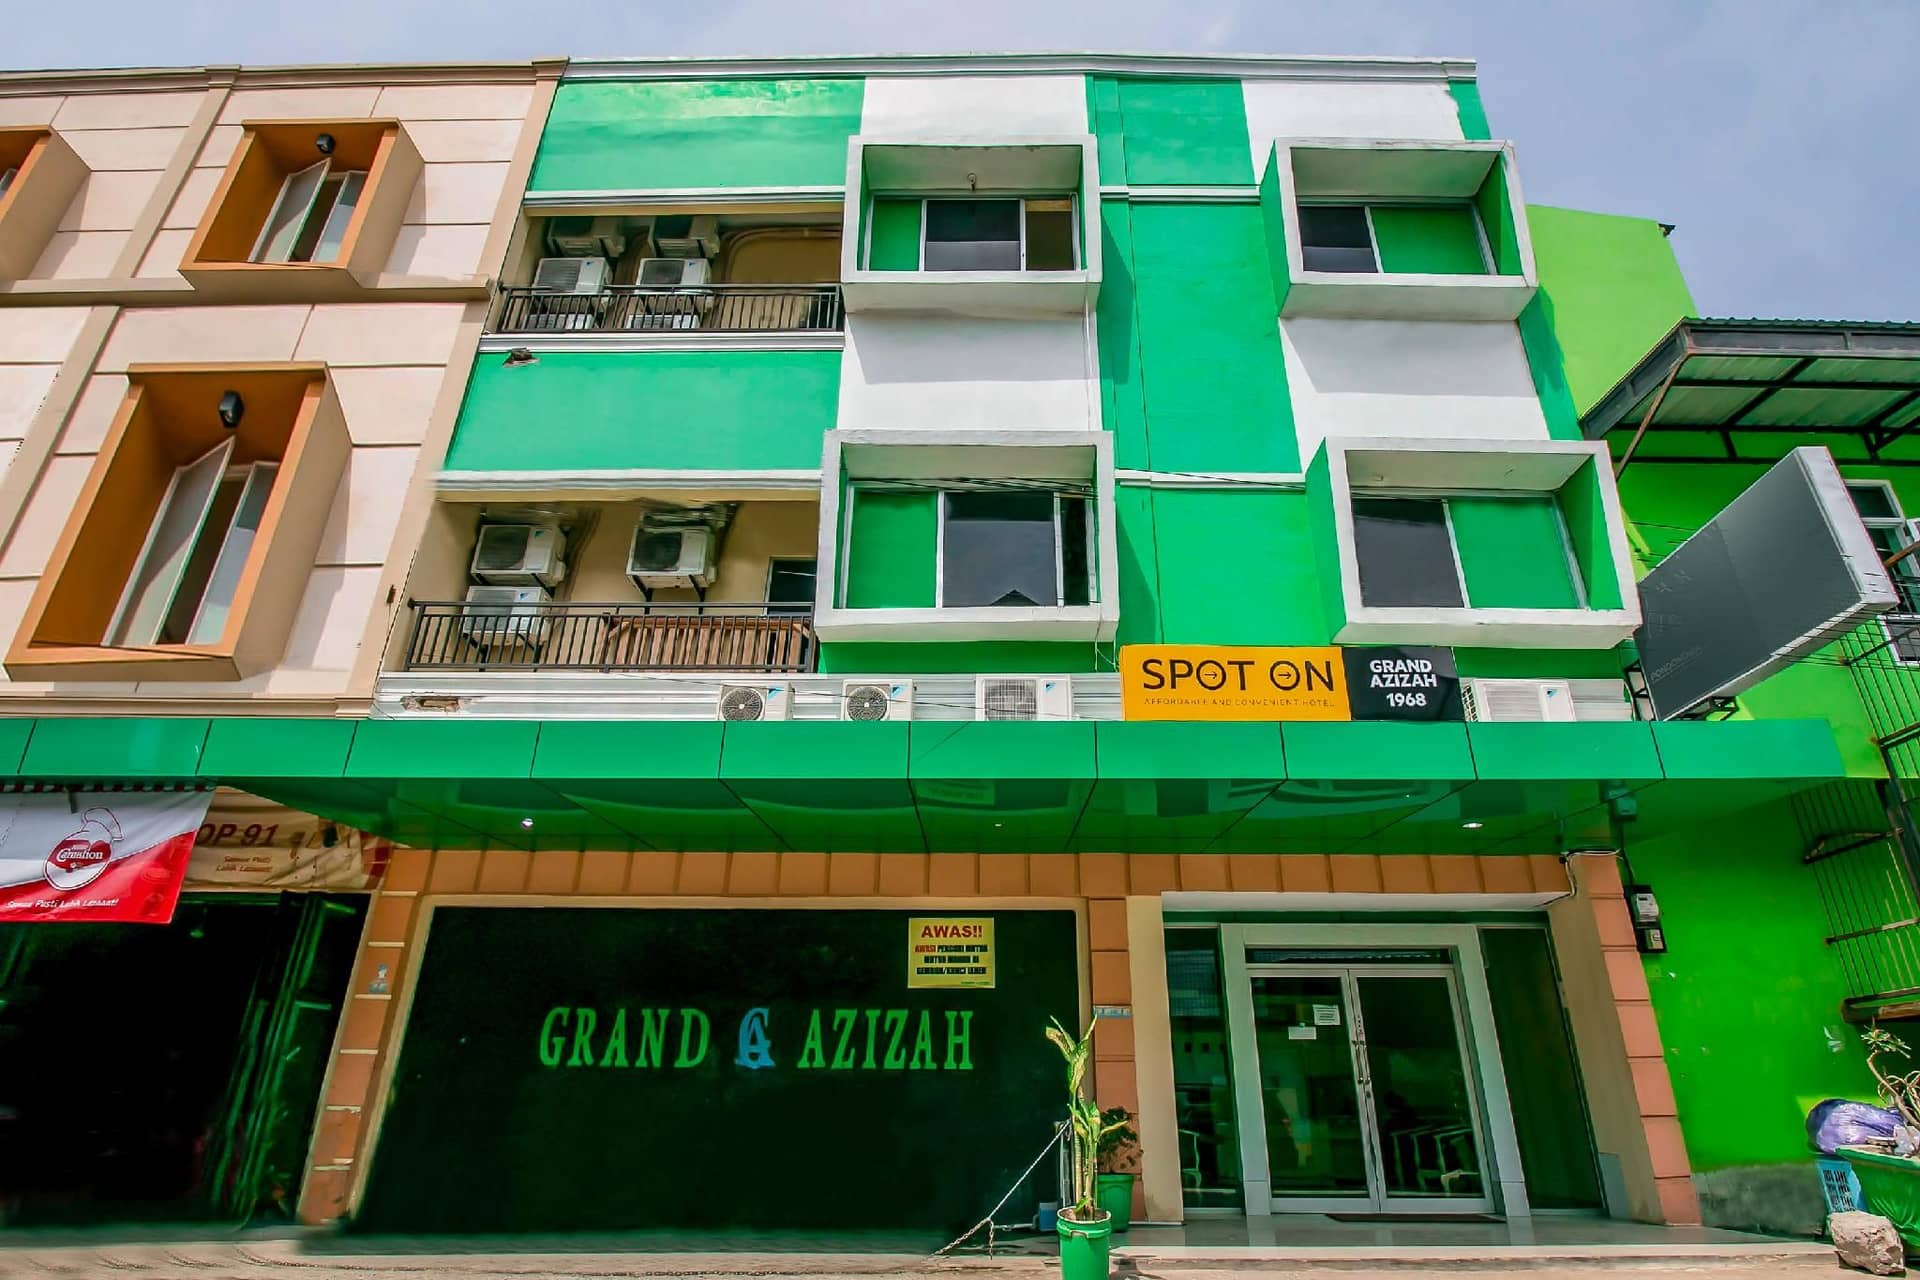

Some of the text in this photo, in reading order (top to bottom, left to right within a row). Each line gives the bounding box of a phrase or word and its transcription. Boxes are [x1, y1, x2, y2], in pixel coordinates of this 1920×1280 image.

[1369, 659, 1432, 674] GRAND
[1141, 657, 1334, 692] SPOT ON
[1369, 673, 1438, 688] AZIZAH
[1211, 698, 1231, 707] AND
[1386, 692, 1427, 708] 1968
[240, 823, 279, 847] 91
[56, 848, 104, 862] Carnation
[921, 925, 982, 938] AWAS!!
[539, 1006, 711, 1069] GRAND
[797, 1008, 974, 1070] AZIZAH
